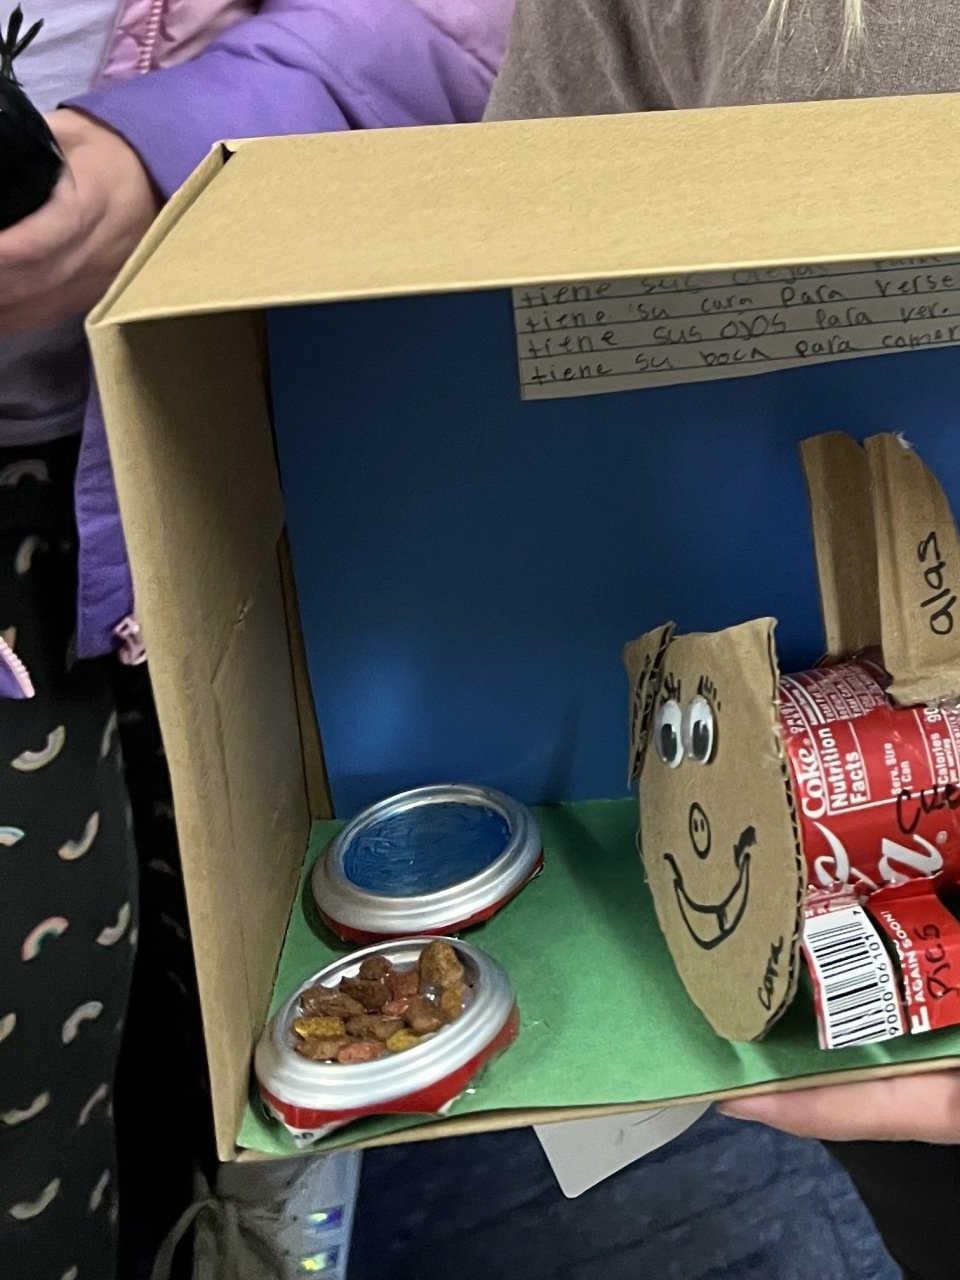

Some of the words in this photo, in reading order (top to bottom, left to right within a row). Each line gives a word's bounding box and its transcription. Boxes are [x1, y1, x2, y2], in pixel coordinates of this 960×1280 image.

[525, 310, 606, 333] tiene
[637, 302, 670, 321] su
[528, 329, 620, 358] tiene
[653, 324, 703, 345] sus
[531, 362, 614, 386] tiene
[635, 352, 676, 370] su
[816, 727, 849, 809] Nutrition
[845, 751, 868, 803] Facts
[929, 732, 950, 786] Calories
[880, 910, 914, 948] SOON!
[903, 950, 926, 1003] AGAIN
